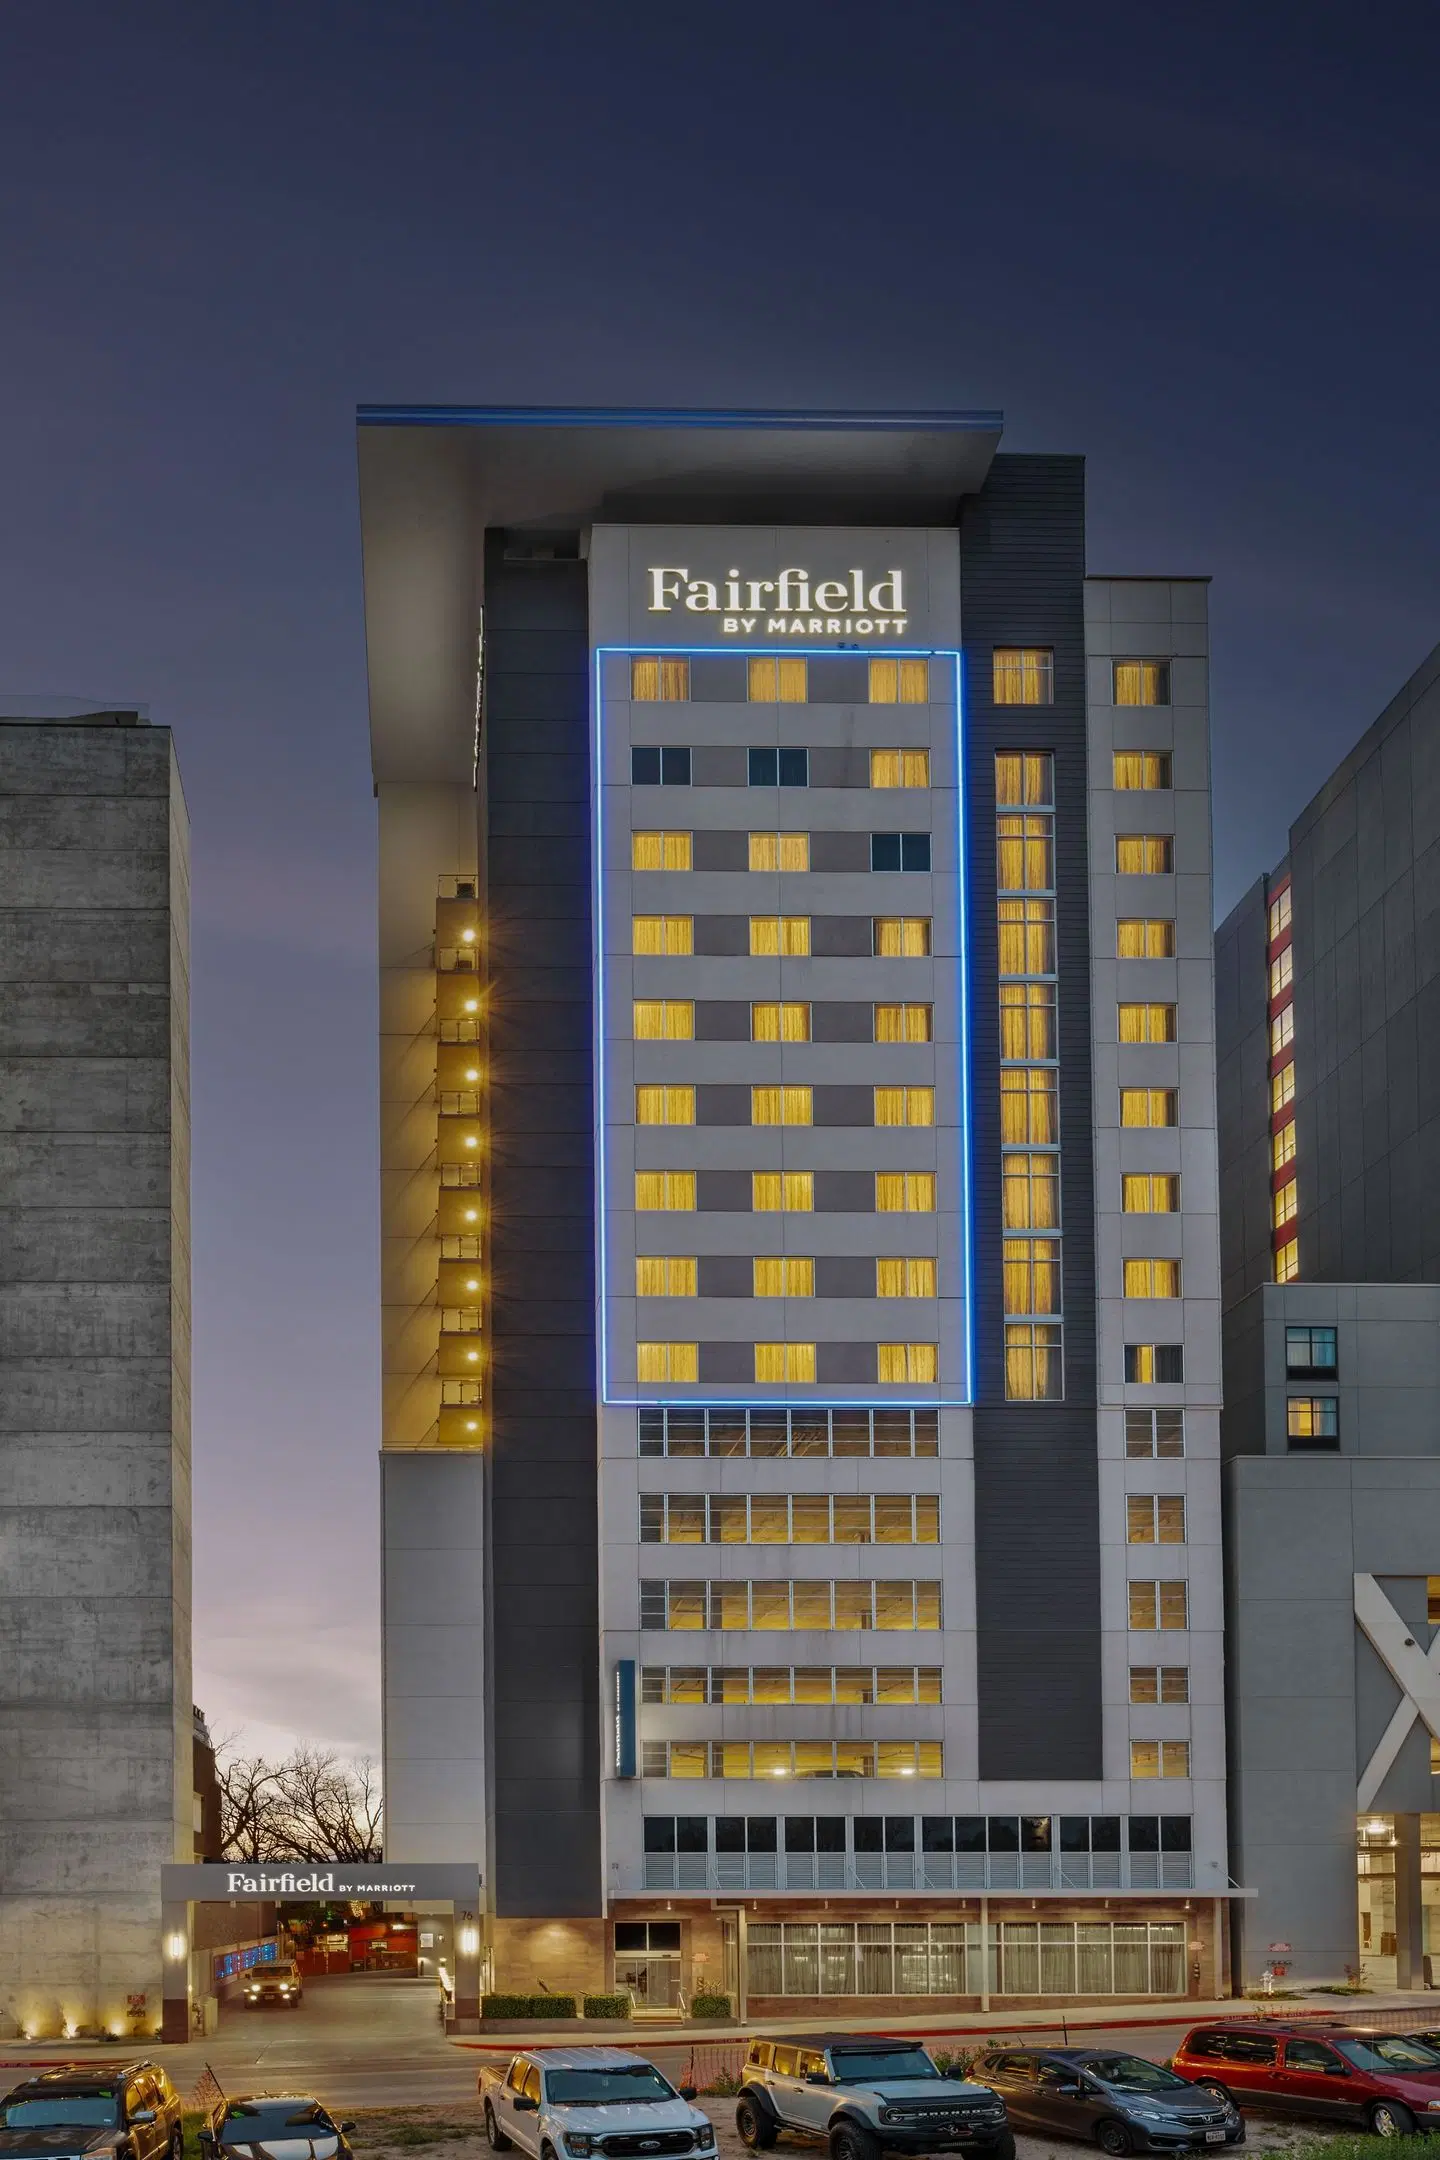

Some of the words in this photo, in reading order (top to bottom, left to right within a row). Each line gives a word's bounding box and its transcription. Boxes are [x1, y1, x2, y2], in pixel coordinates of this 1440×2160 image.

[647, 568, 907, 613] Fairfield
[723, 617, 757, 633] BY
[767, 618, 908, 635] MARRIOTT
[227, 1872, 335, 1893] Fairfield
[339, 1884, 353, 1892] BY
[357, 1884, 416, 1892] MARRIOTT
